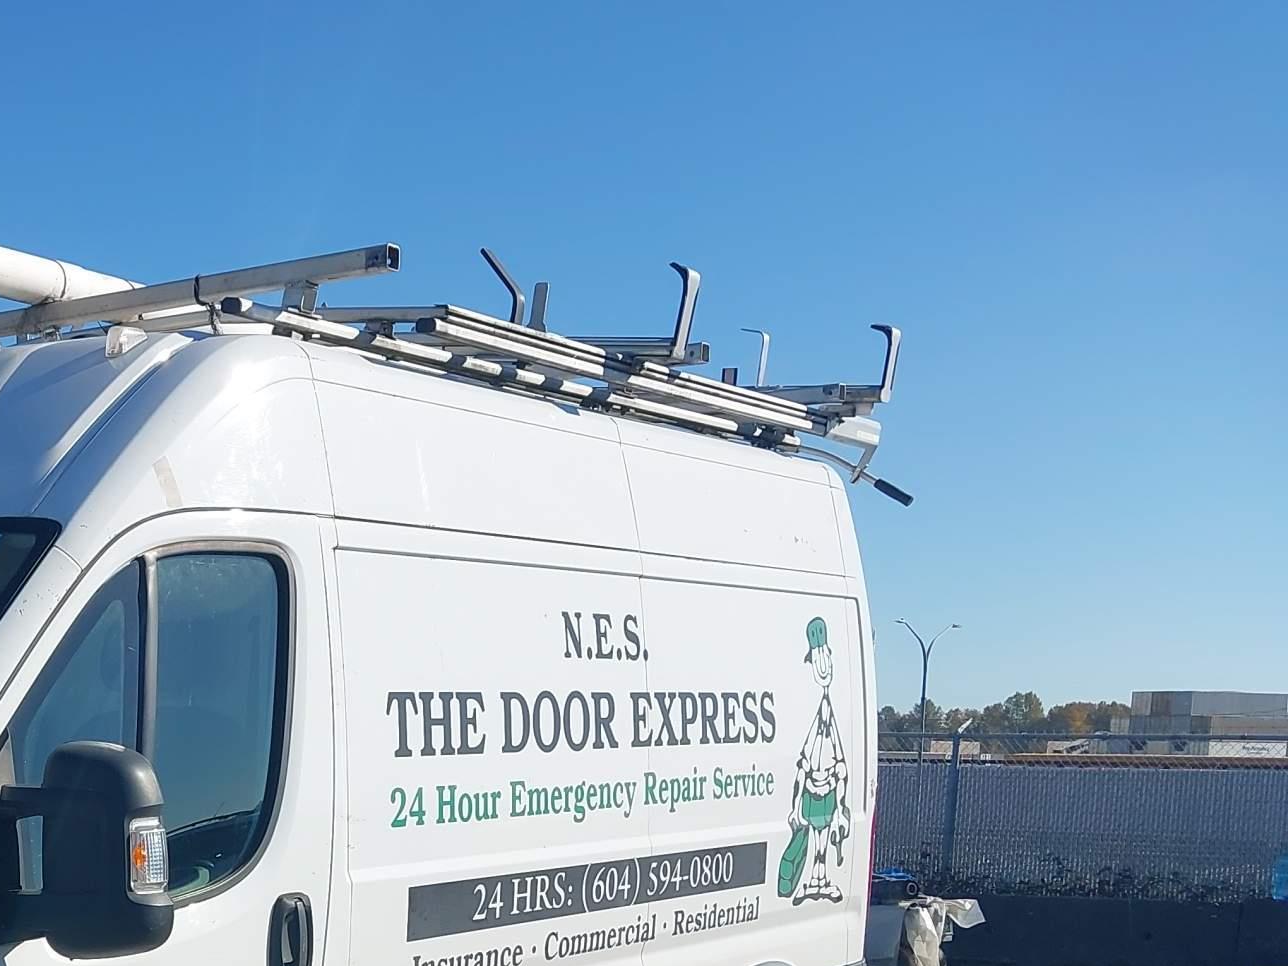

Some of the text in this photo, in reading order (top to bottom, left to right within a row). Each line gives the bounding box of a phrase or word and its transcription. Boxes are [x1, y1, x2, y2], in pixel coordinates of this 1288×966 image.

[562, 612, 649, 661] N.E.S.
[386, 691, 776, 757] THE DOOR EXPRESS
[390, 764, 774, 827] 24 Hour Emergency Repair Service
[472, 852, 733, 921] 24 HRS: (604) 594-0800
[544, 914, 656, 961] Commercial
[672, 898, 760, 936] Residential
